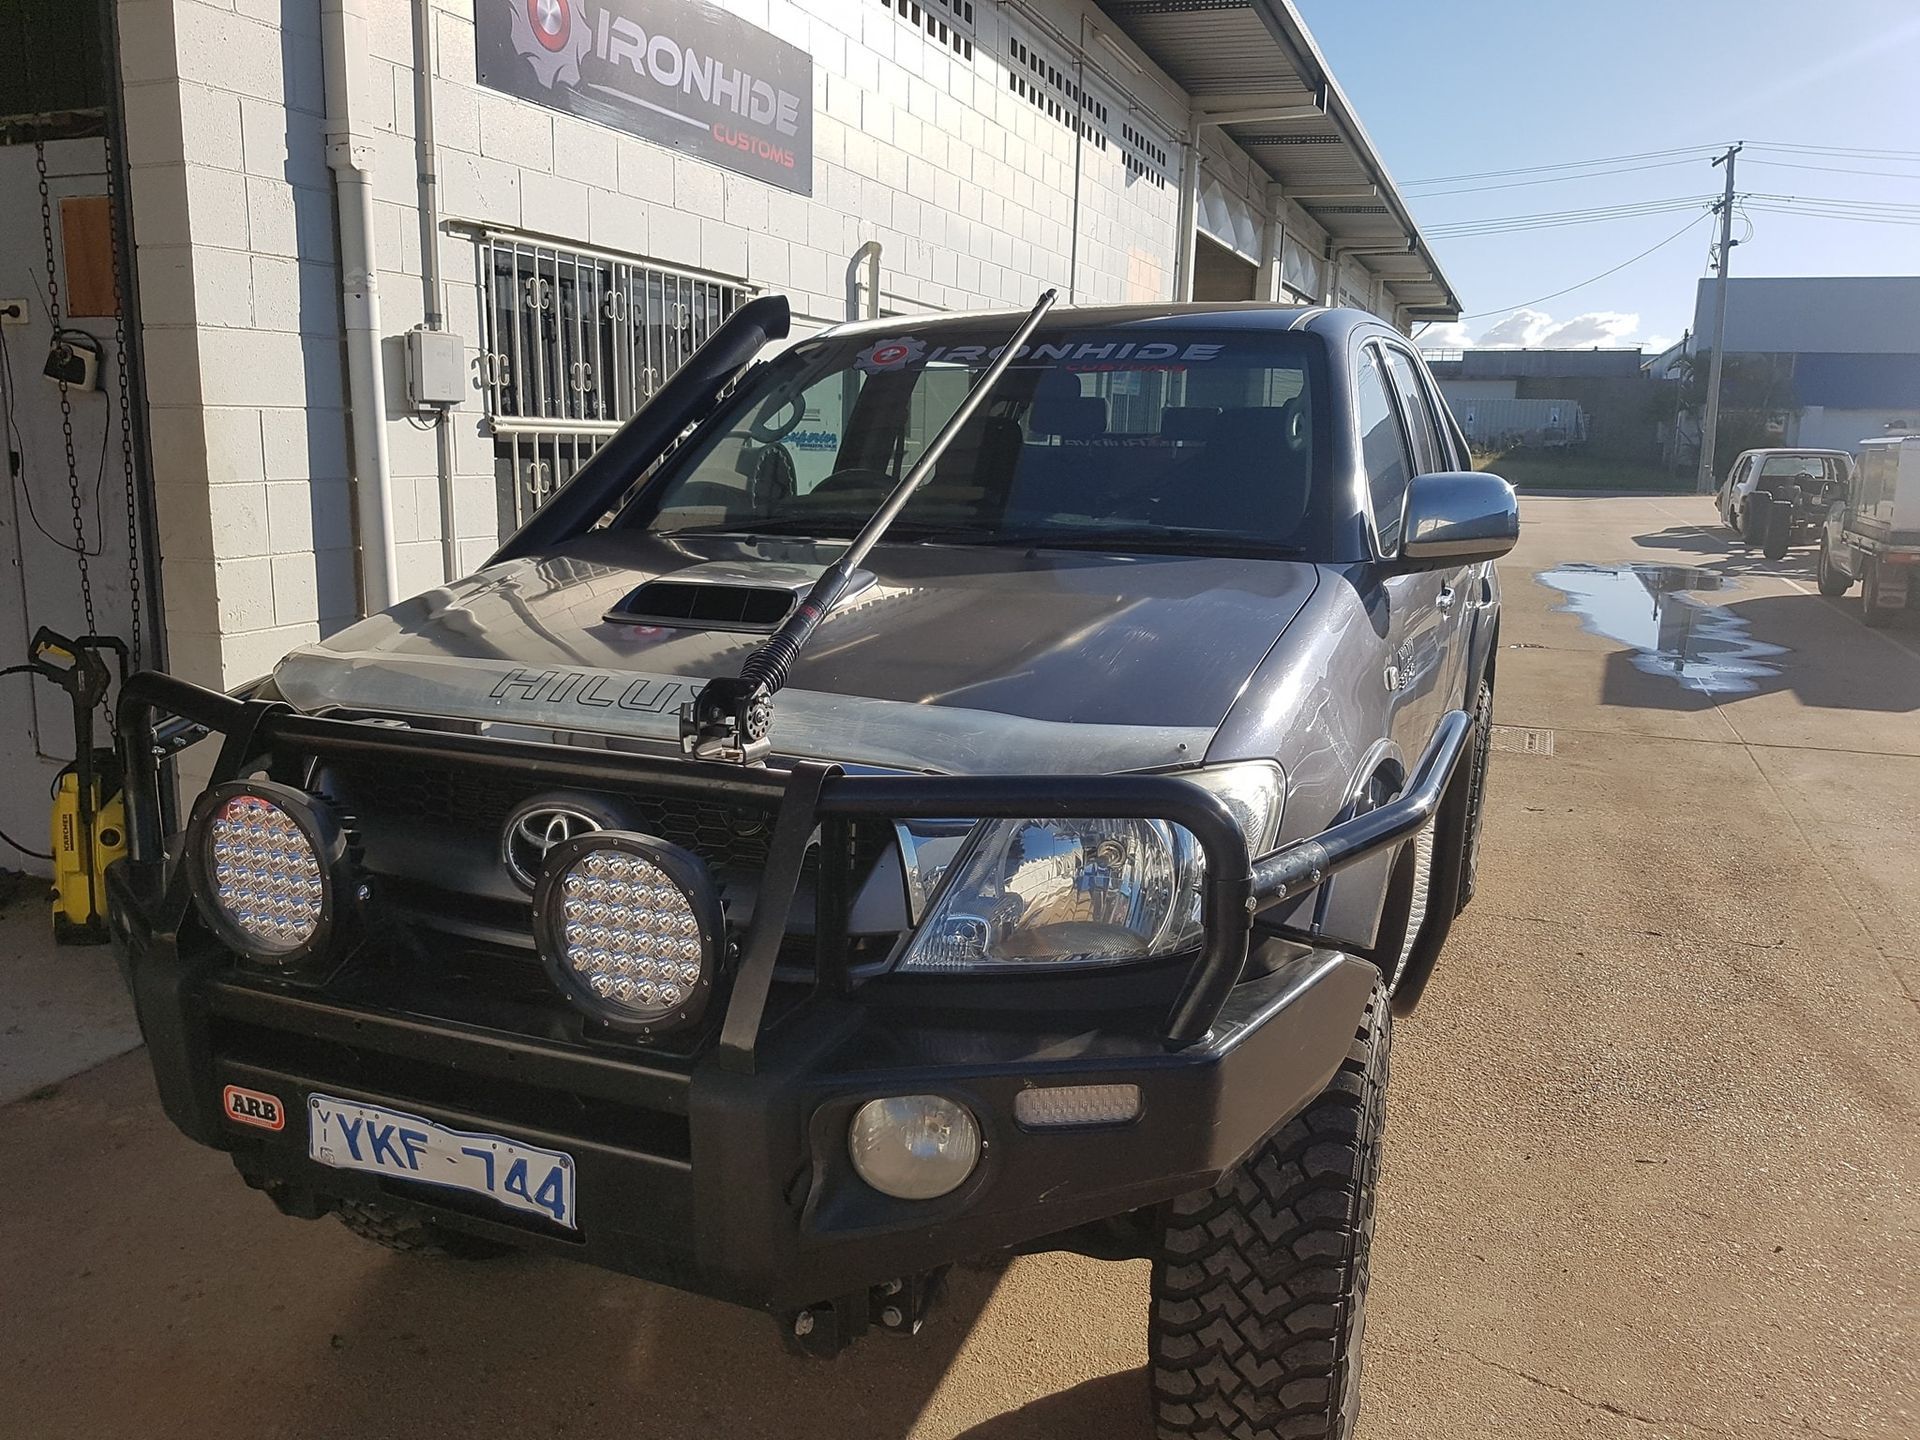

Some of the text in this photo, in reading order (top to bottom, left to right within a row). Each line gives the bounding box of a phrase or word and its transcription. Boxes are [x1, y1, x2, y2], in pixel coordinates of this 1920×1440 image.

[597, 8, 800, 137] IRONHIDE
[712, 122, 795, 169] CUSTOMS
[1065, 363, 1187, 373] CUSTOMS
[232, 1093, 278, 1122] ARB
